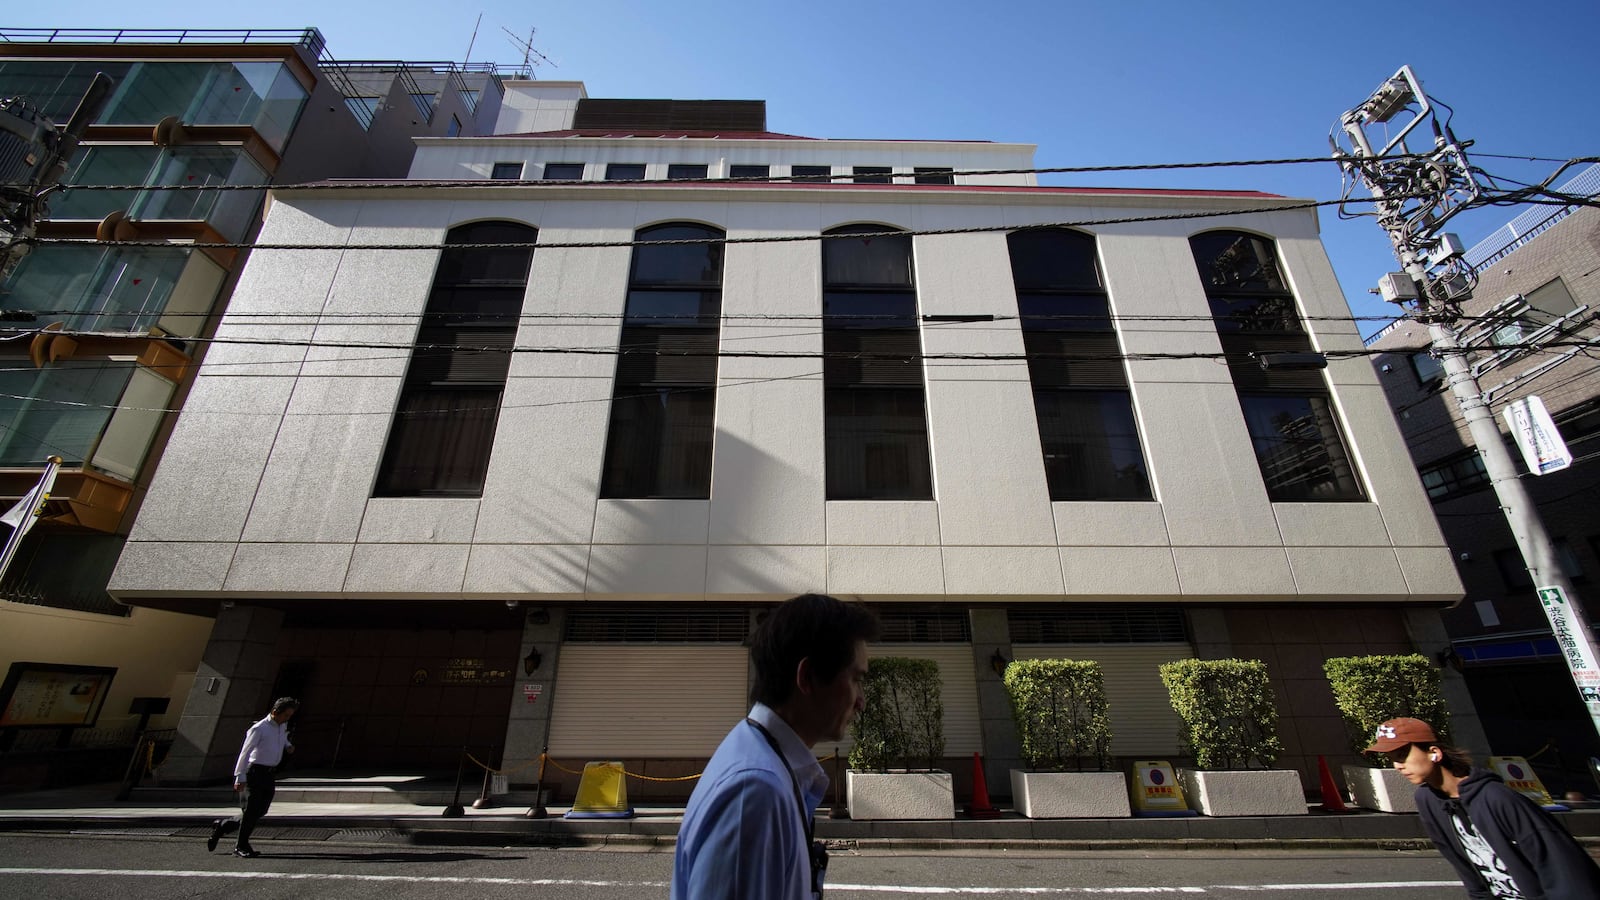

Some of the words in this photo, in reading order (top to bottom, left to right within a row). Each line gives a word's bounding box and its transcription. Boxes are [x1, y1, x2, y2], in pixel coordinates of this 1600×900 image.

[1548, 607, 1586, 669] 渋谷犬猫病院
